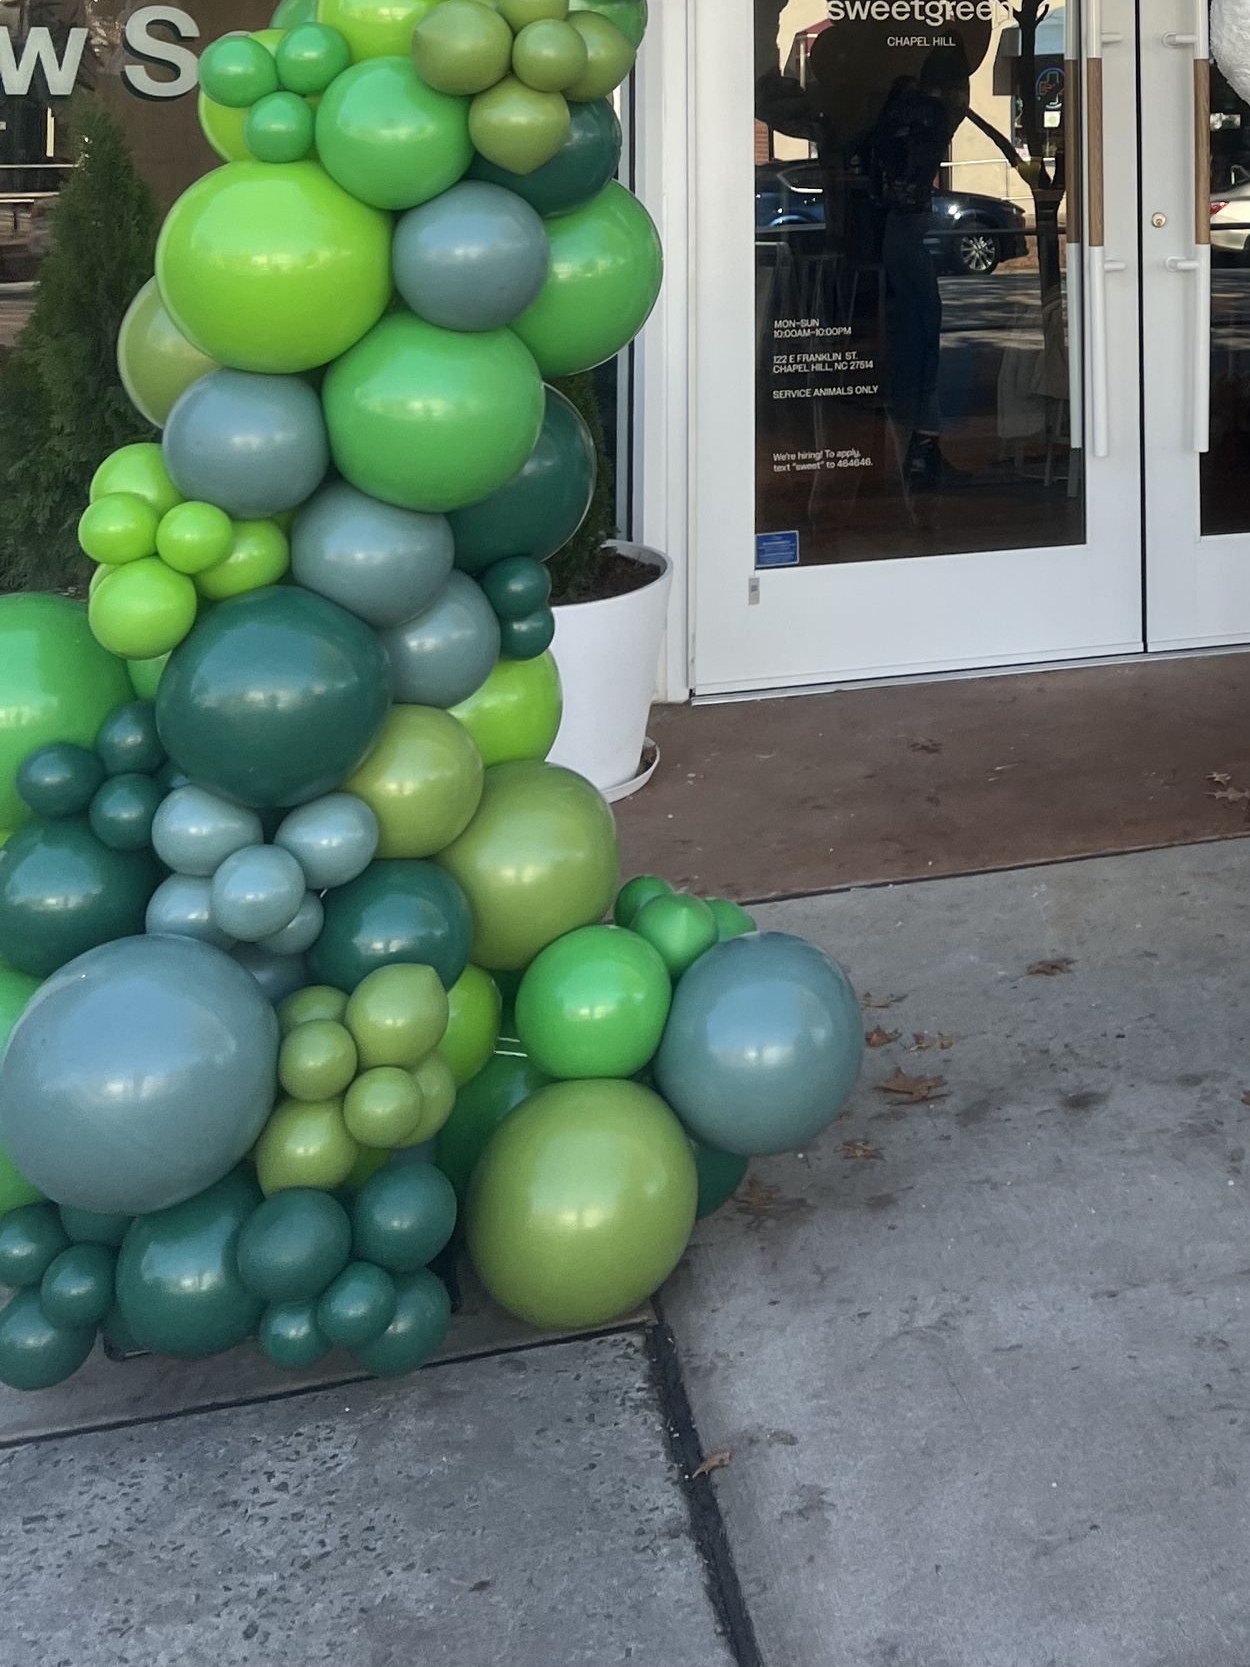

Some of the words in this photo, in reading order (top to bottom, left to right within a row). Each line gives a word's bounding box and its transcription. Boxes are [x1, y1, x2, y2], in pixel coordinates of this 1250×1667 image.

[887, 36, 931, 47] CHAPEL
[933, 36, 956, 47] HILL
[773, 355, 787, 364] 122
[789, 354, 795, 363] E
[797, 352, 841, 363] FRANKLIN
[845, 351, 858, 360] ST.
[773, 363, 809, 374] CHAPEL
[811, 362, 833, 372] HILL,
[834, 361, 848, 370] NC
[849, 360, 874, 370] 27514
[773, 388, 812, 399] SERVICE
[813, 386, 854, 397] ANIMALS
[855, 385, 879, 395] ONLY
[797, 450, 823, 461] hiring!
[824, 449, 835, 458] To
[773, 464, 790, 472] text
